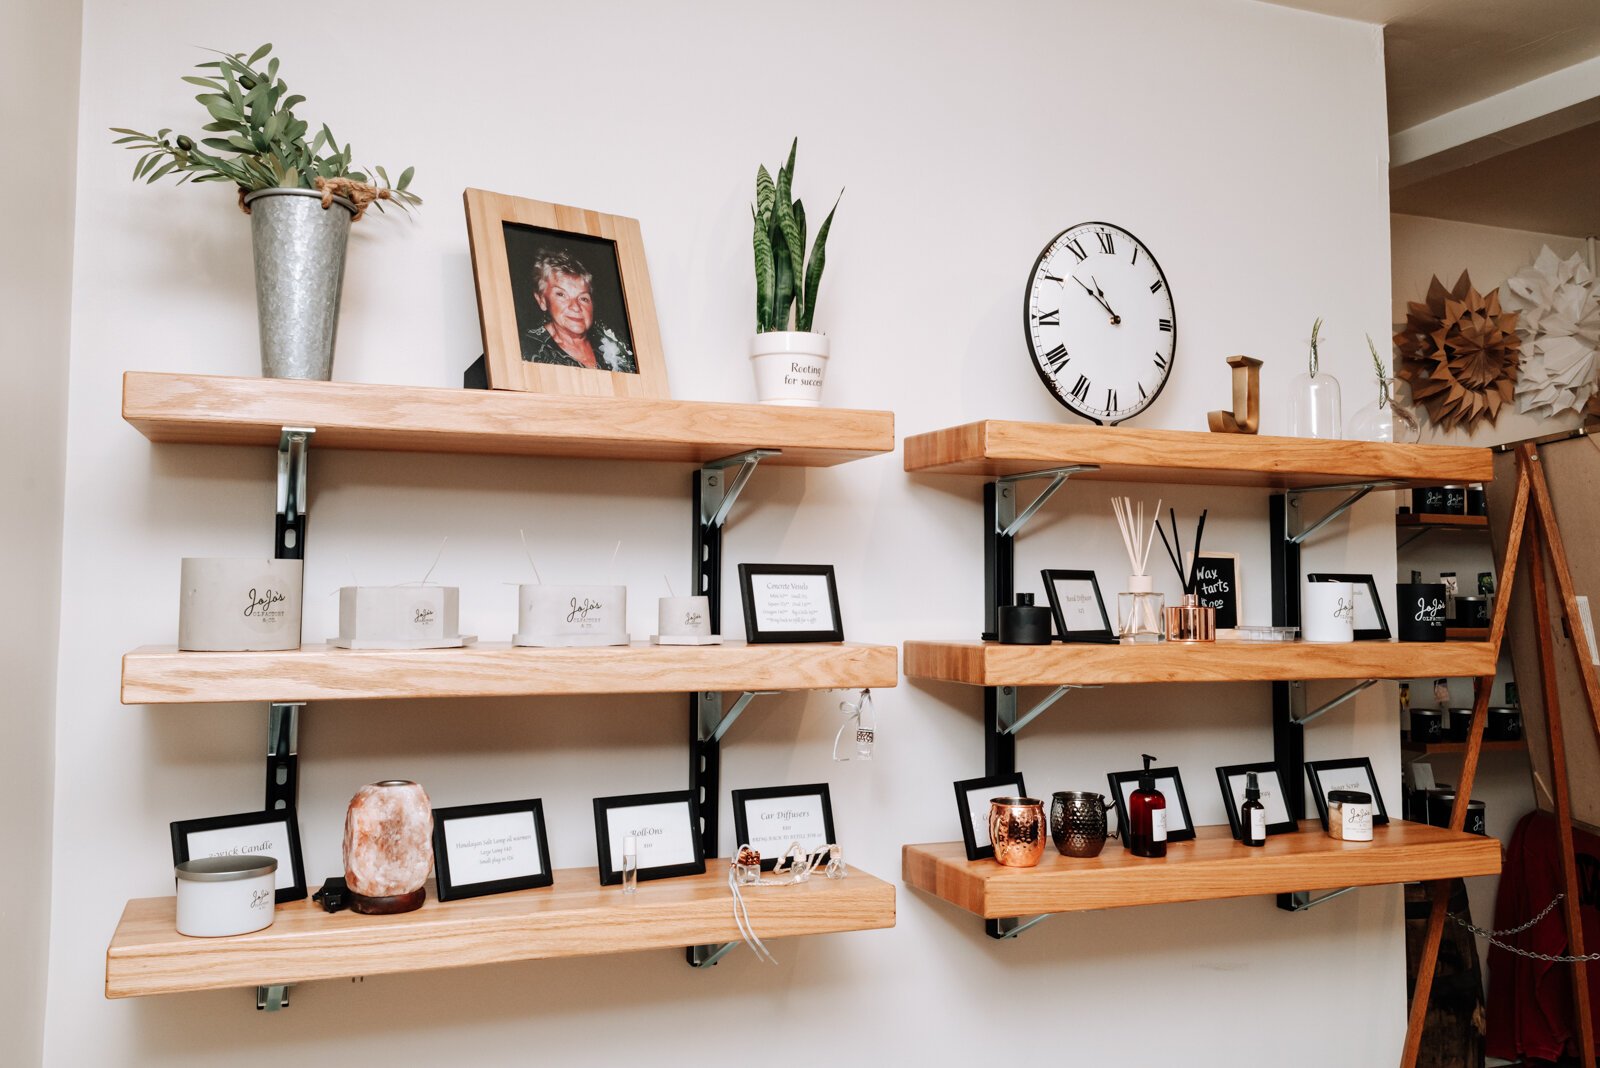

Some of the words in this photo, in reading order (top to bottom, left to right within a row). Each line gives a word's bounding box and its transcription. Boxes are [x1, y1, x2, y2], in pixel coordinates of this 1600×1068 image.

[791, 362, 822, 377] Rooting
[784, 374, 798, 385] for
[1196, 566, 1218, 581] Wax
[766, 582, 790, 591] Concrete
[790, 583, 809, 591] Vessels
[1201, 579, 1230, 595] tarts
[244, 588, 286, 617] JoJo's
[567, 597, 603, 623] JoJo's
[1415, 597, 1446, 621] JoJo's
[760, 811, 775, 821] Car
[777, 809, 811, 821] Diffusers
[631, 827, 663, 838] Roll-Ons
[241, 840, 273, 854] Candle
